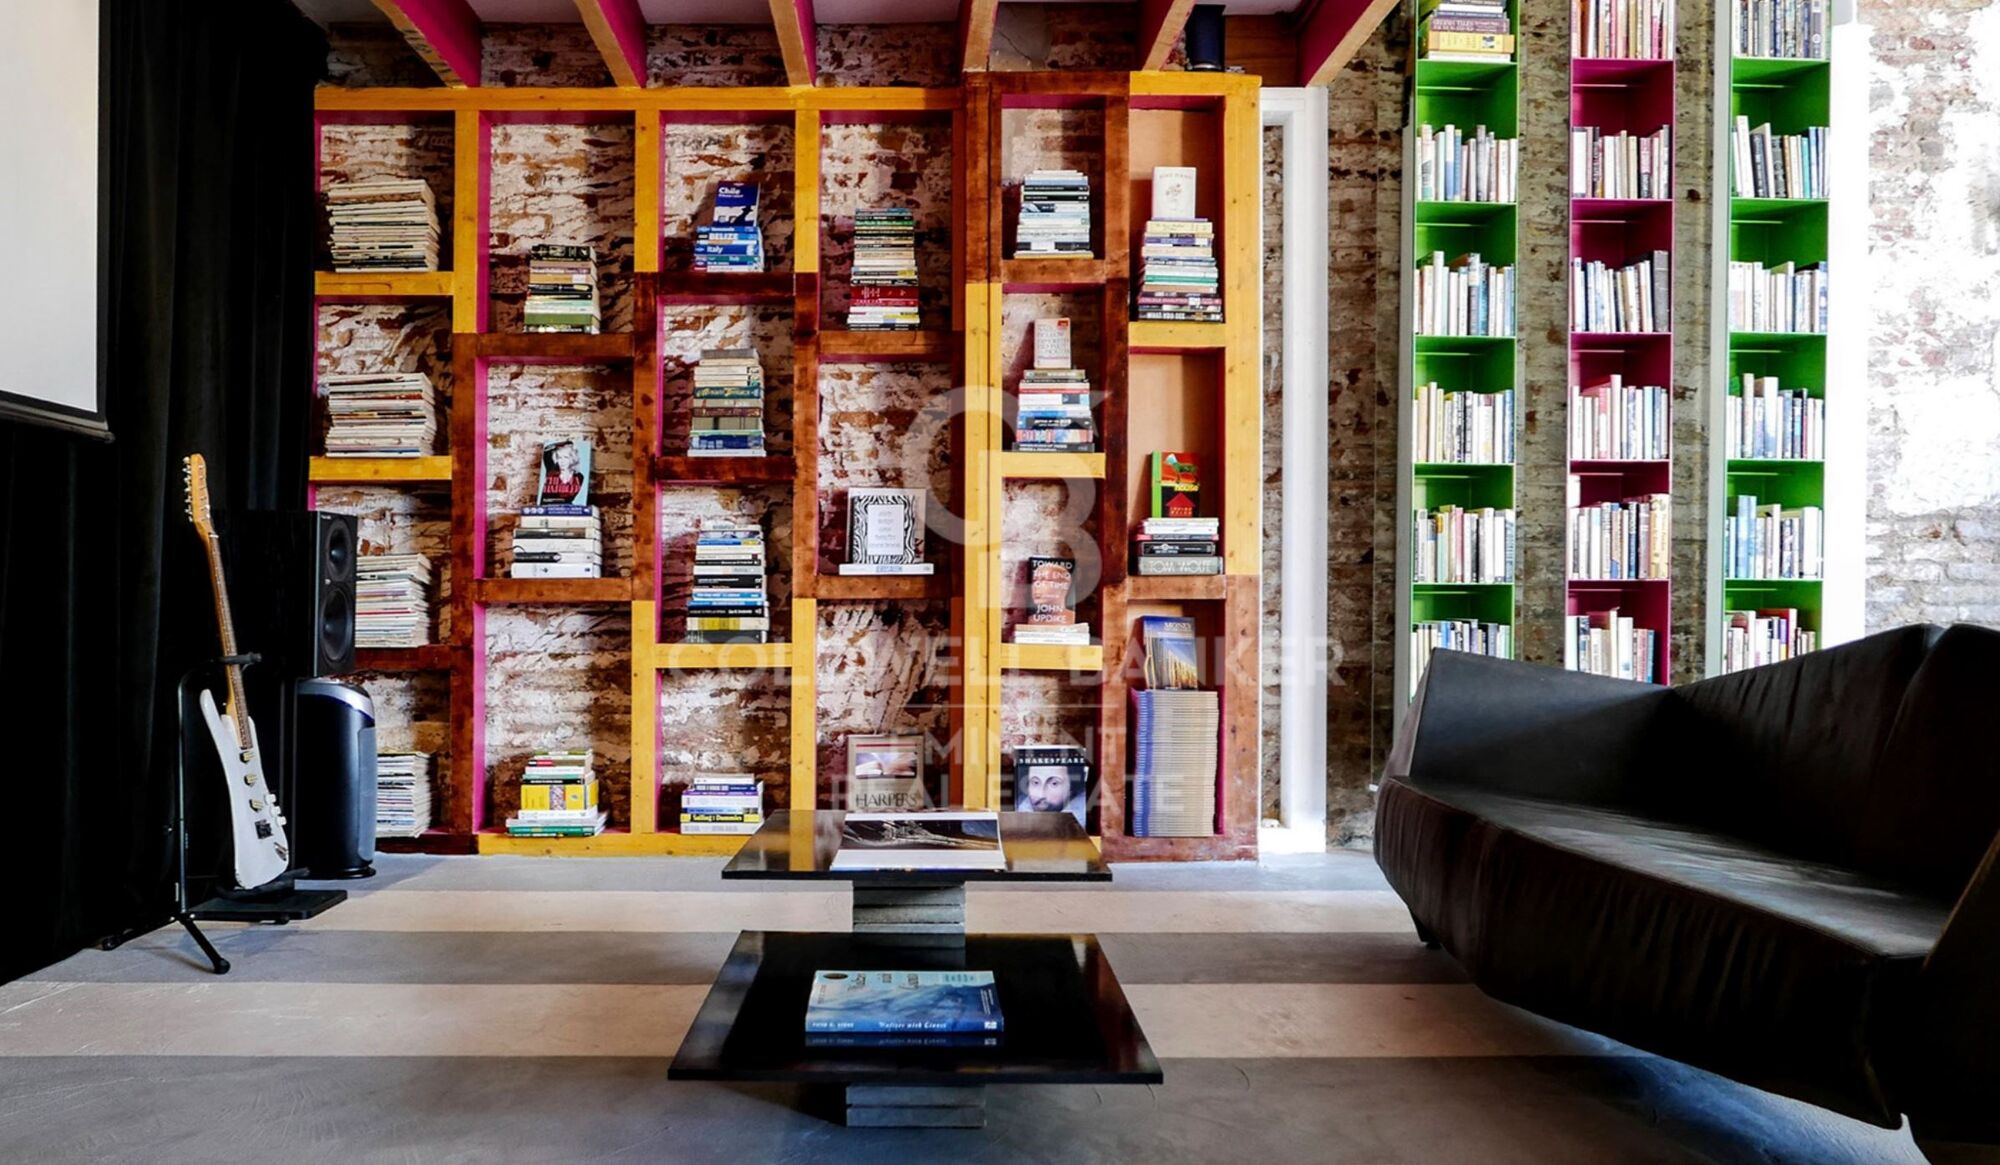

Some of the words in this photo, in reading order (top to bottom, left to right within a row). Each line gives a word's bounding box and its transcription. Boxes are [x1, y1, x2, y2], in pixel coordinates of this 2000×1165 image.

[718, 187, 740, 195] Chile
[707, 246, 723, 254] Italy
[1032, 560, 1073, 569] TOWARD
[1050, 582, 1069, 590] TIME
[1036, 604, 1063, 613] JOHN
[1033, 614, 1067, 622] UPDIKE
